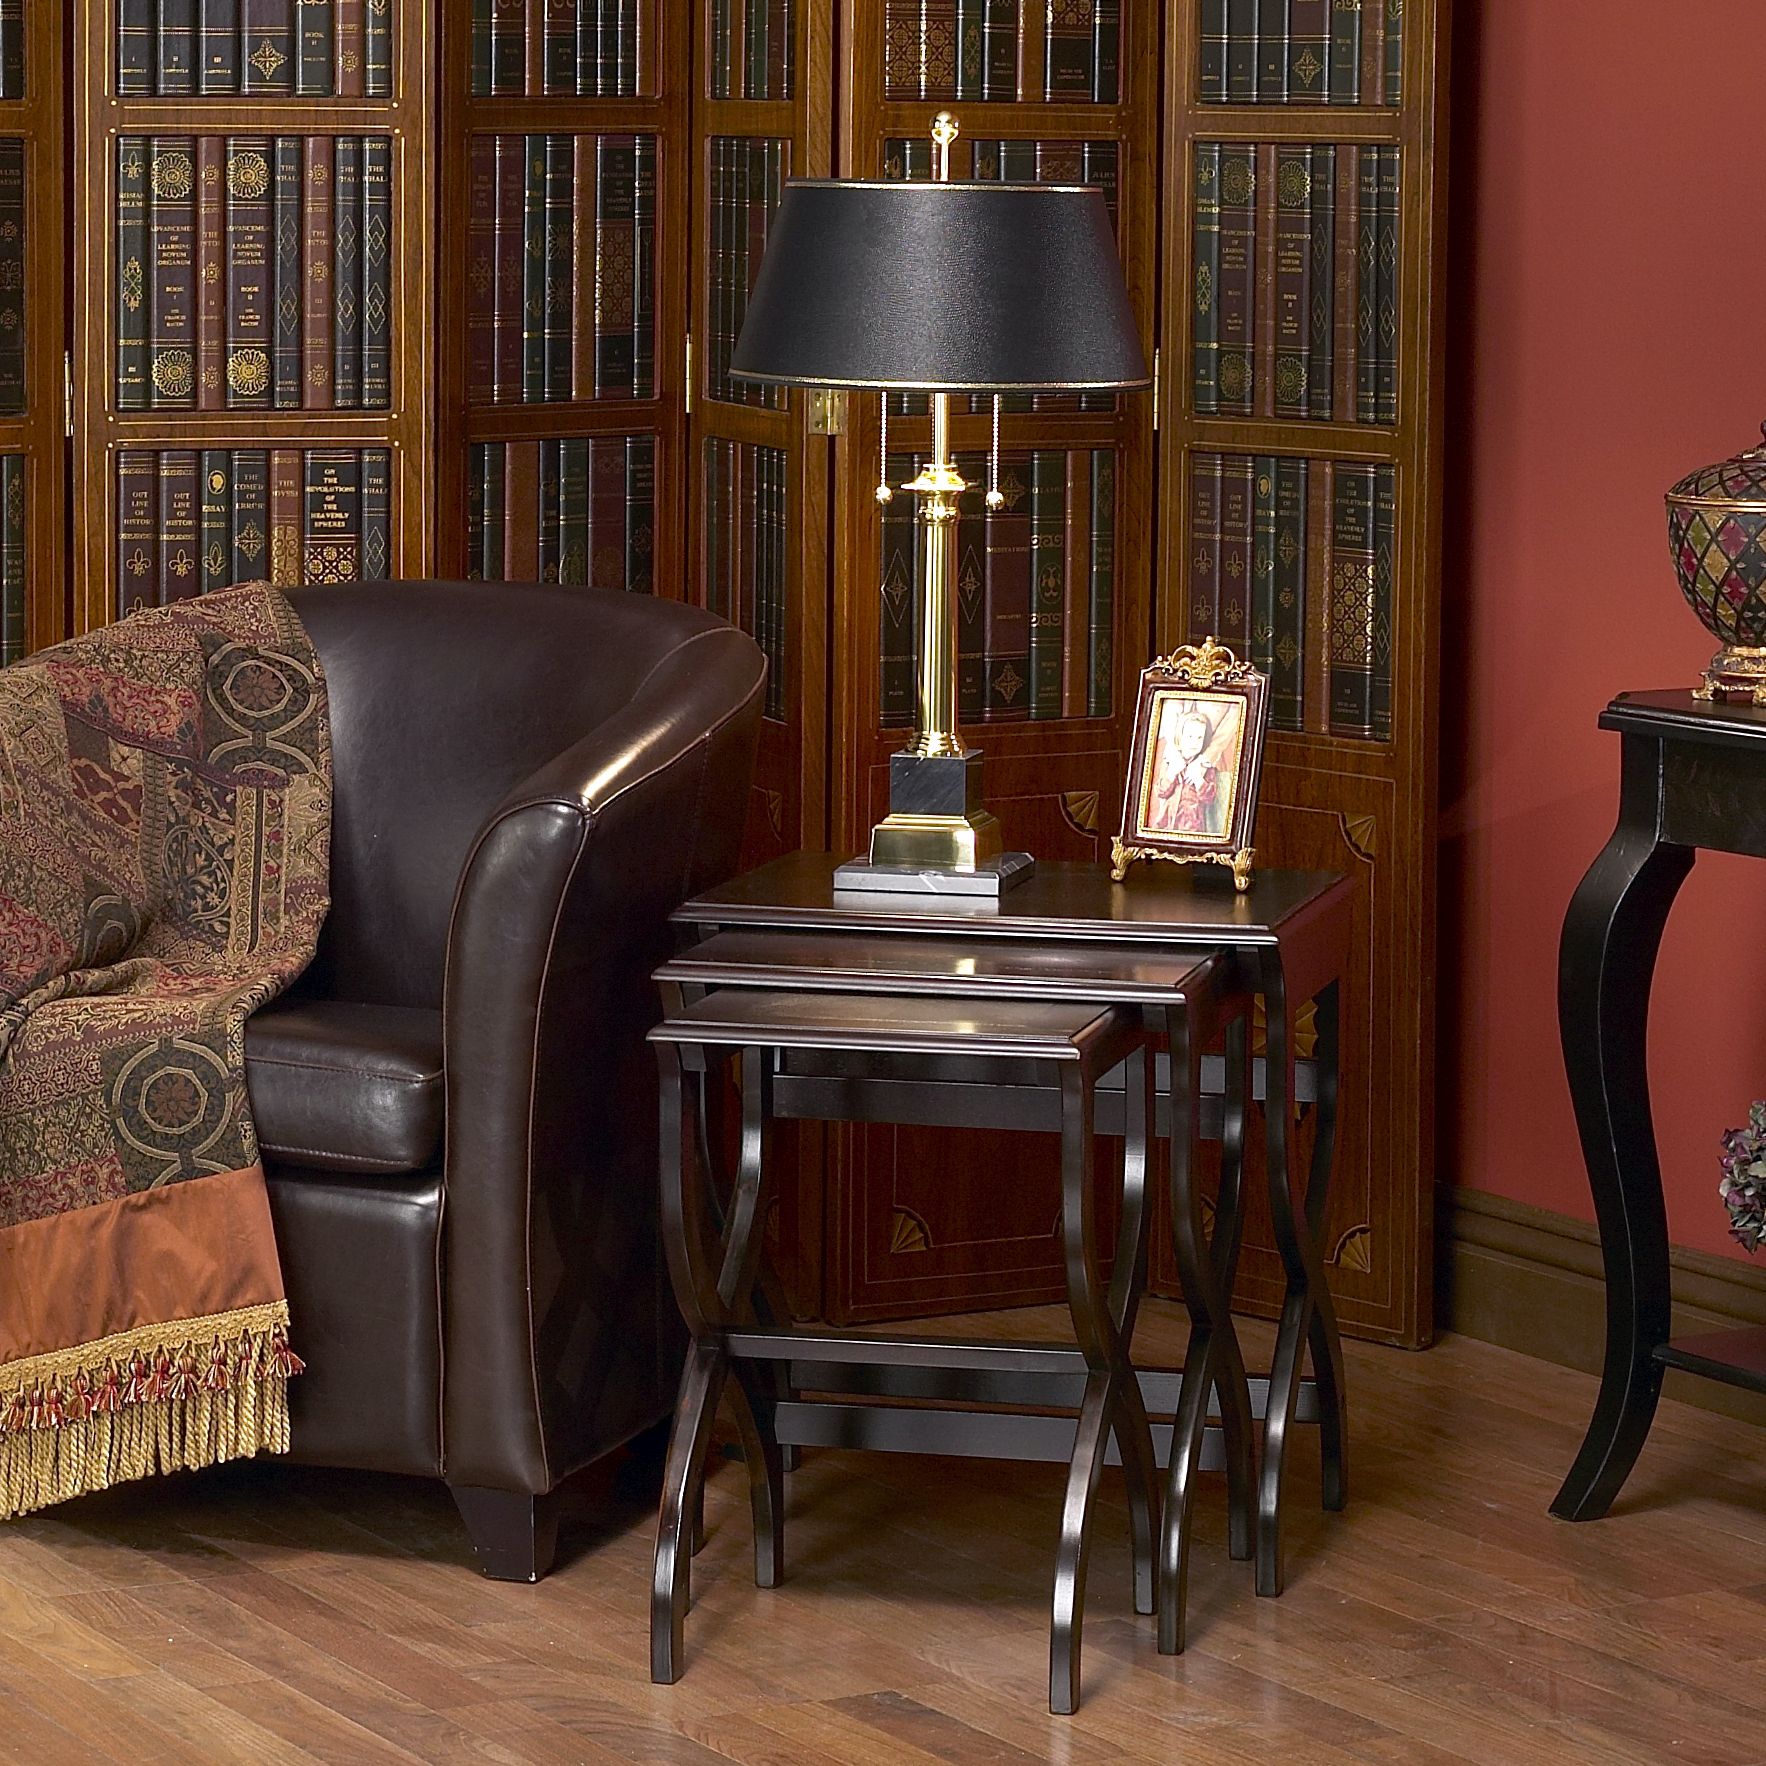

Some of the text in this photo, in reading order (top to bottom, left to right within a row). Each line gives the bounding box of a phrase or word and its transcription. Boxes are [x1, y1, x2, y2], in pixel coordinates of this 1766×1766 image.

[368, 165, 385, 173] THE
[244, 473, 259, 481] THE
[368, 477, 385, 485] THE
[234, 483, 264, 491] COMED
[305, 485, 356, 493] REVOLUTIONS
[174, 492, 191, 500] OUT
